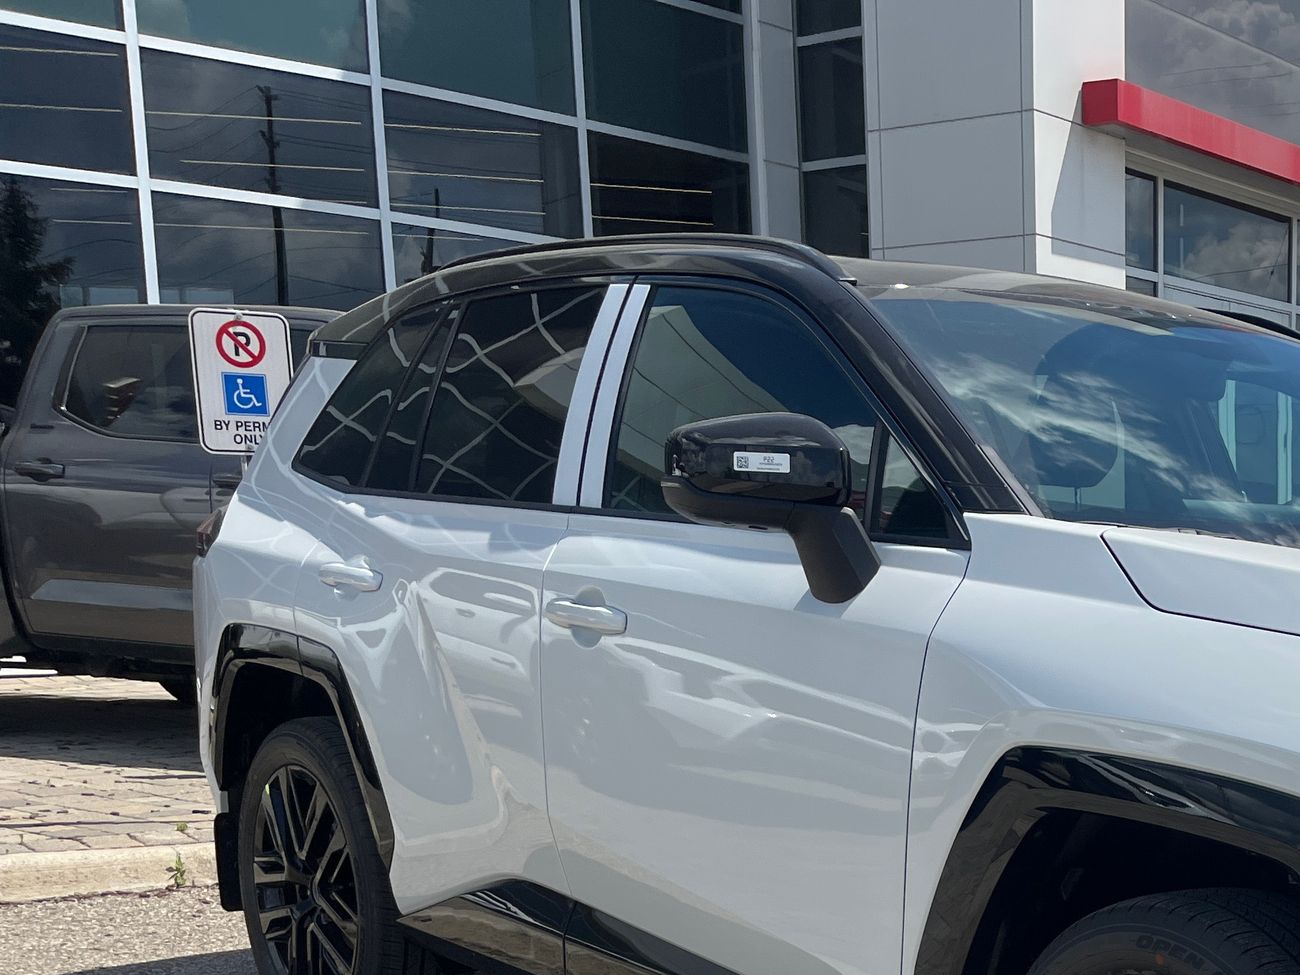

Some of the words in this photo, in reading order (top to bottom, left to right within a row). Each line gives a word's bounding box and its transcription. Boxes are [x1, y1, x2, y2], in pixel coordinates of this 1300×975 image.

[214, 420, 231, 431] BY
[234, 434, 262, 445] ONL
[1135, 935, 1205, 970] OPEN
